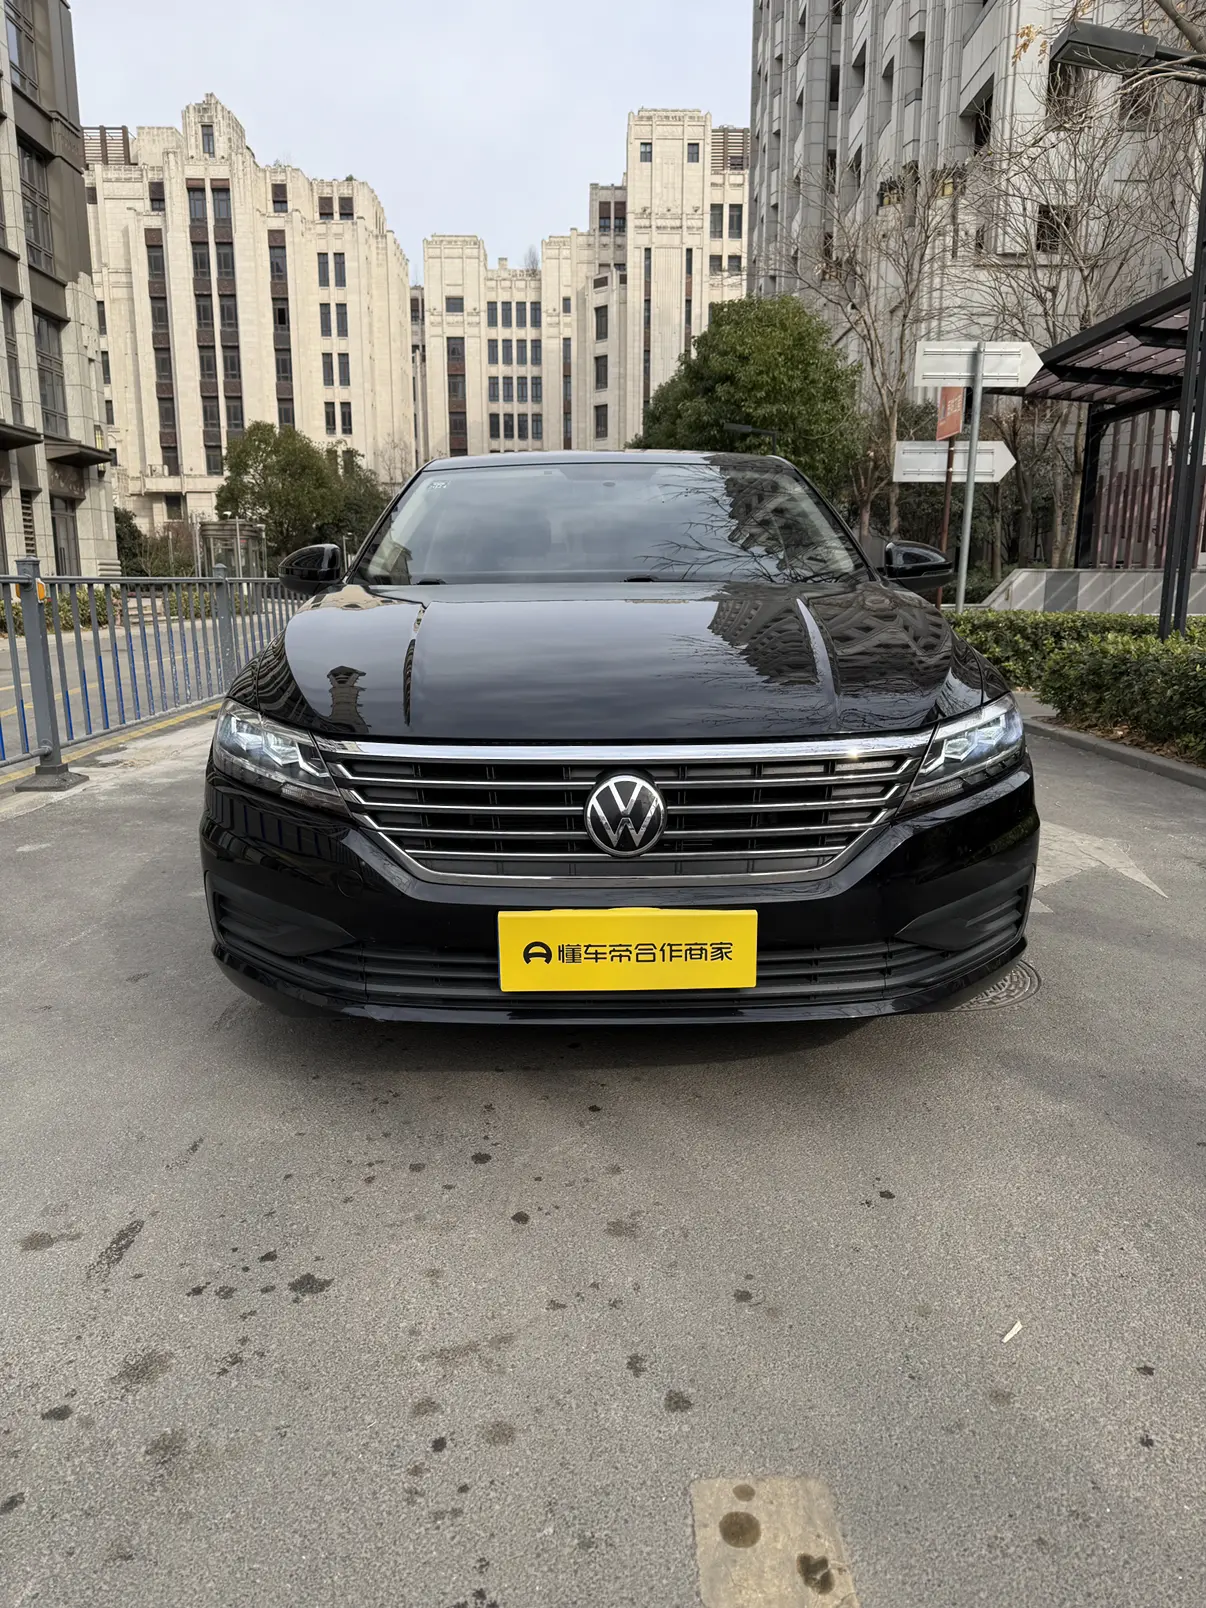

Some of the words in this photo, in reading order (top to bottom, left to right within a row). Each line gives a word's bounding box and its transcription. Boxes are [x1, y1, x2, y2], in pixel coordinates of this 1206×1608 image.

[588, 776, 663, 853] VW
[557, 941, 734, 964] 懂车帝合作商家
